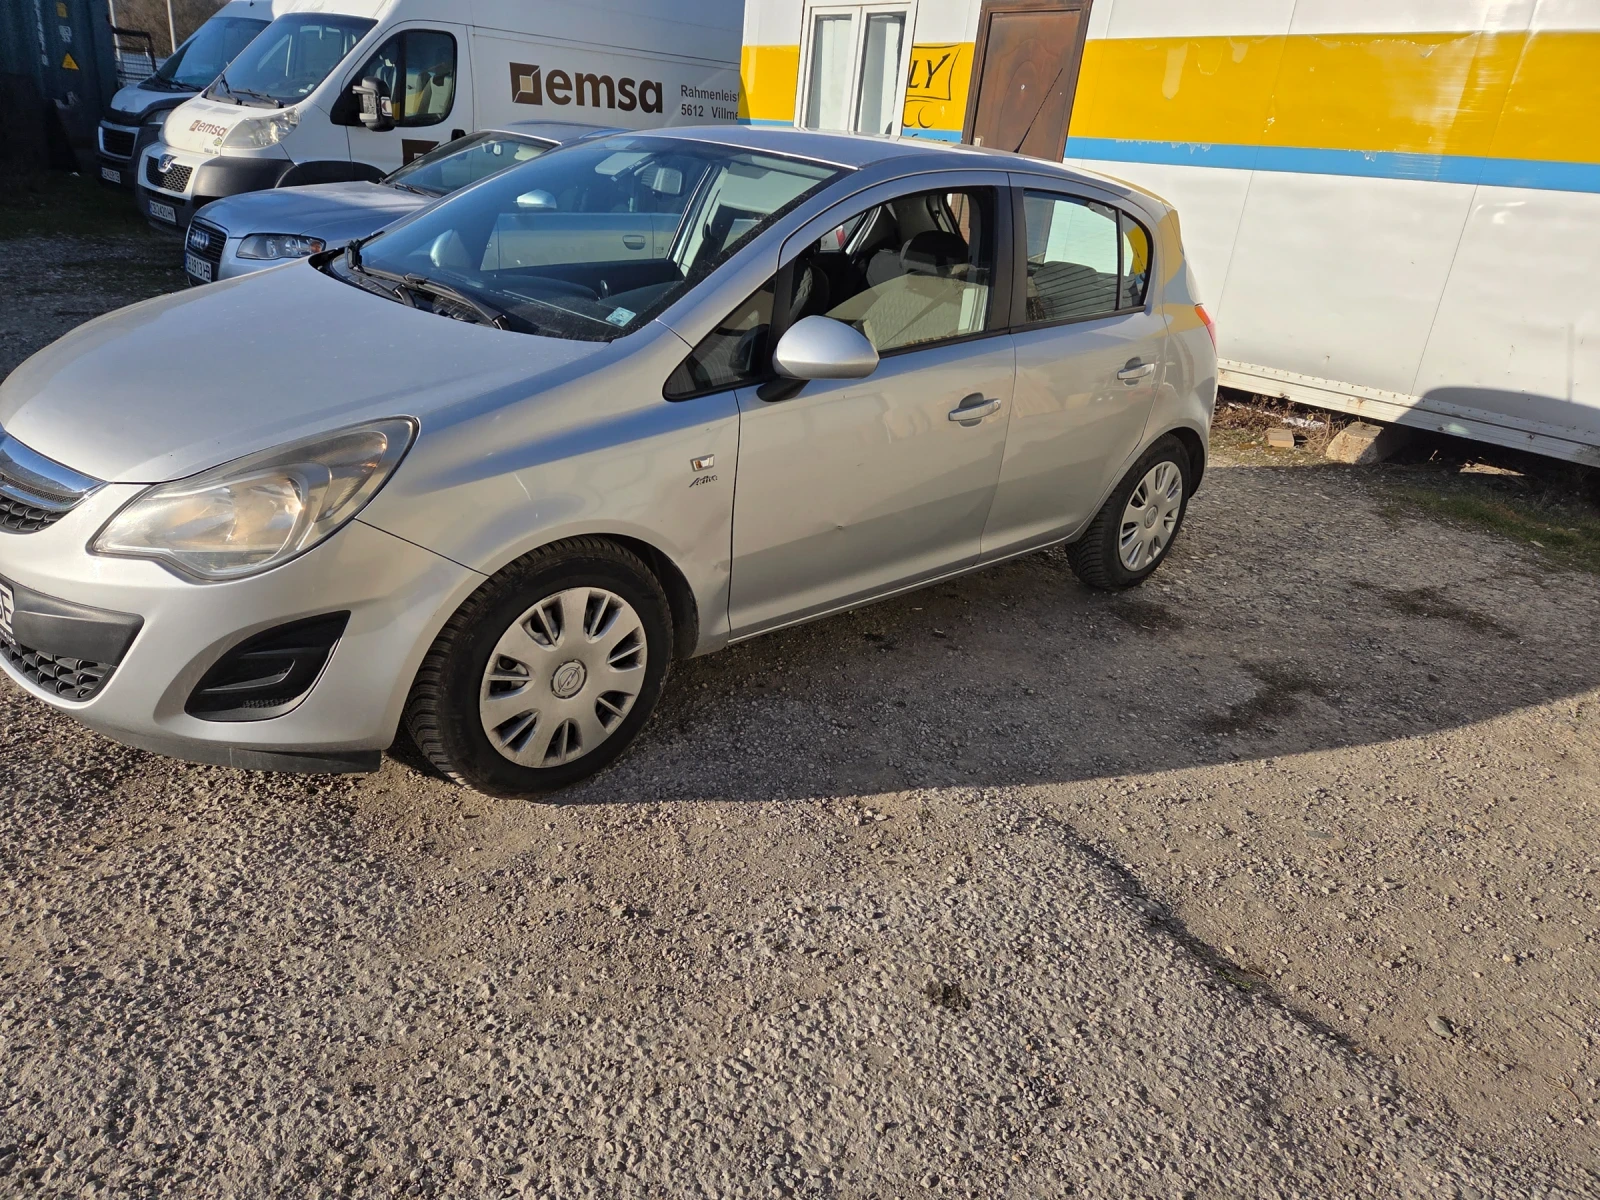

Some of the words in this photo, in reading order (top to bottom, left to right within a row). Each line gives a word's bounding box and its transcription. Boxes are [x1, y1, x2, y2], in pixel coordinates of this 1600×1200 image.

[545, 68, 663, 114] emsa
[681, 103, 704, 117] 5612
[197, 121, 227, 137] emsa
